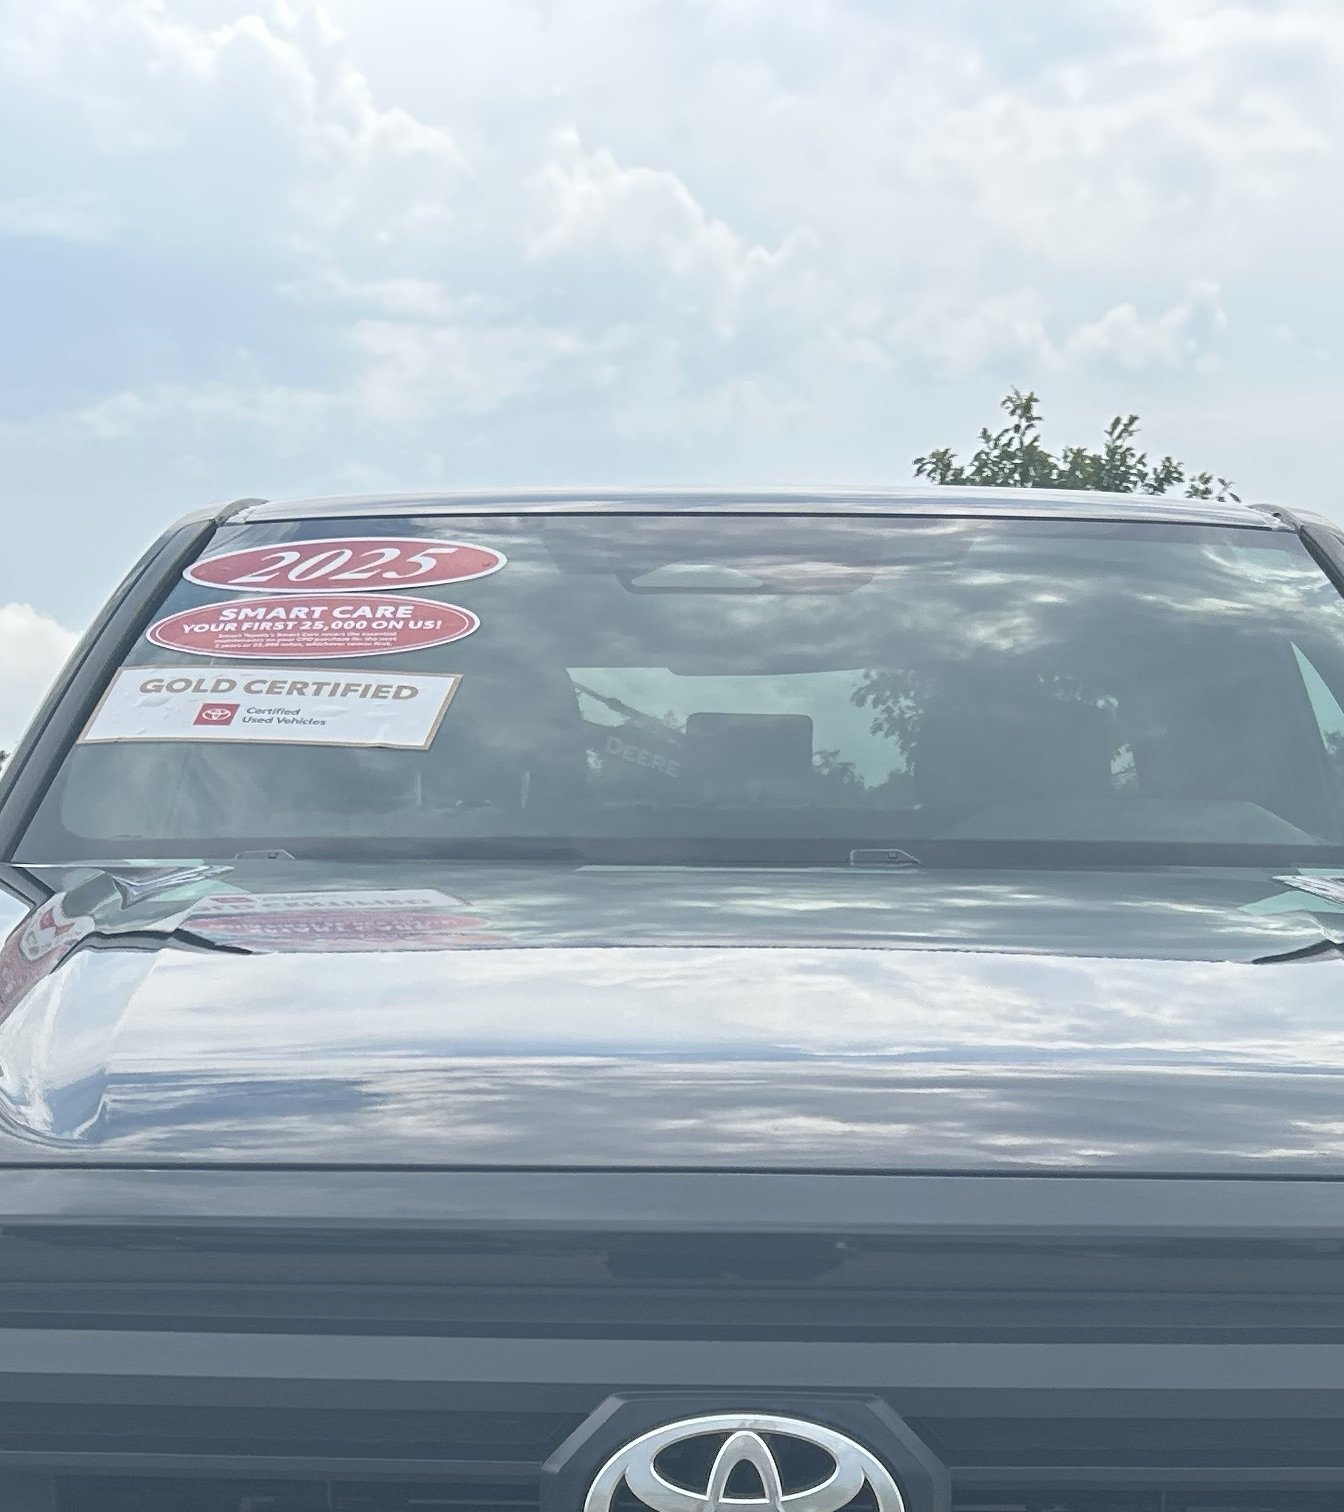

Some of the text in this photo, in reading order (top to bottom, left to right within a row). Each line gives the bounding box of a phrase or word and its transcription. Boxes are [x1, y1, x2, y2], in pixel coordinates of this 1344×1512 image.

[227, 547, 458, 584] 2025
[219, 605, 415, 621] SMART CARE
[183, 619, 442, 634] YOUR FIRST 25,000 ON US!
[139, 677, 419, 701] GOLD CERTIFIED
[246, 706, 301, 716] Certified
[242, 716, 327, 726] Used Vehicles
